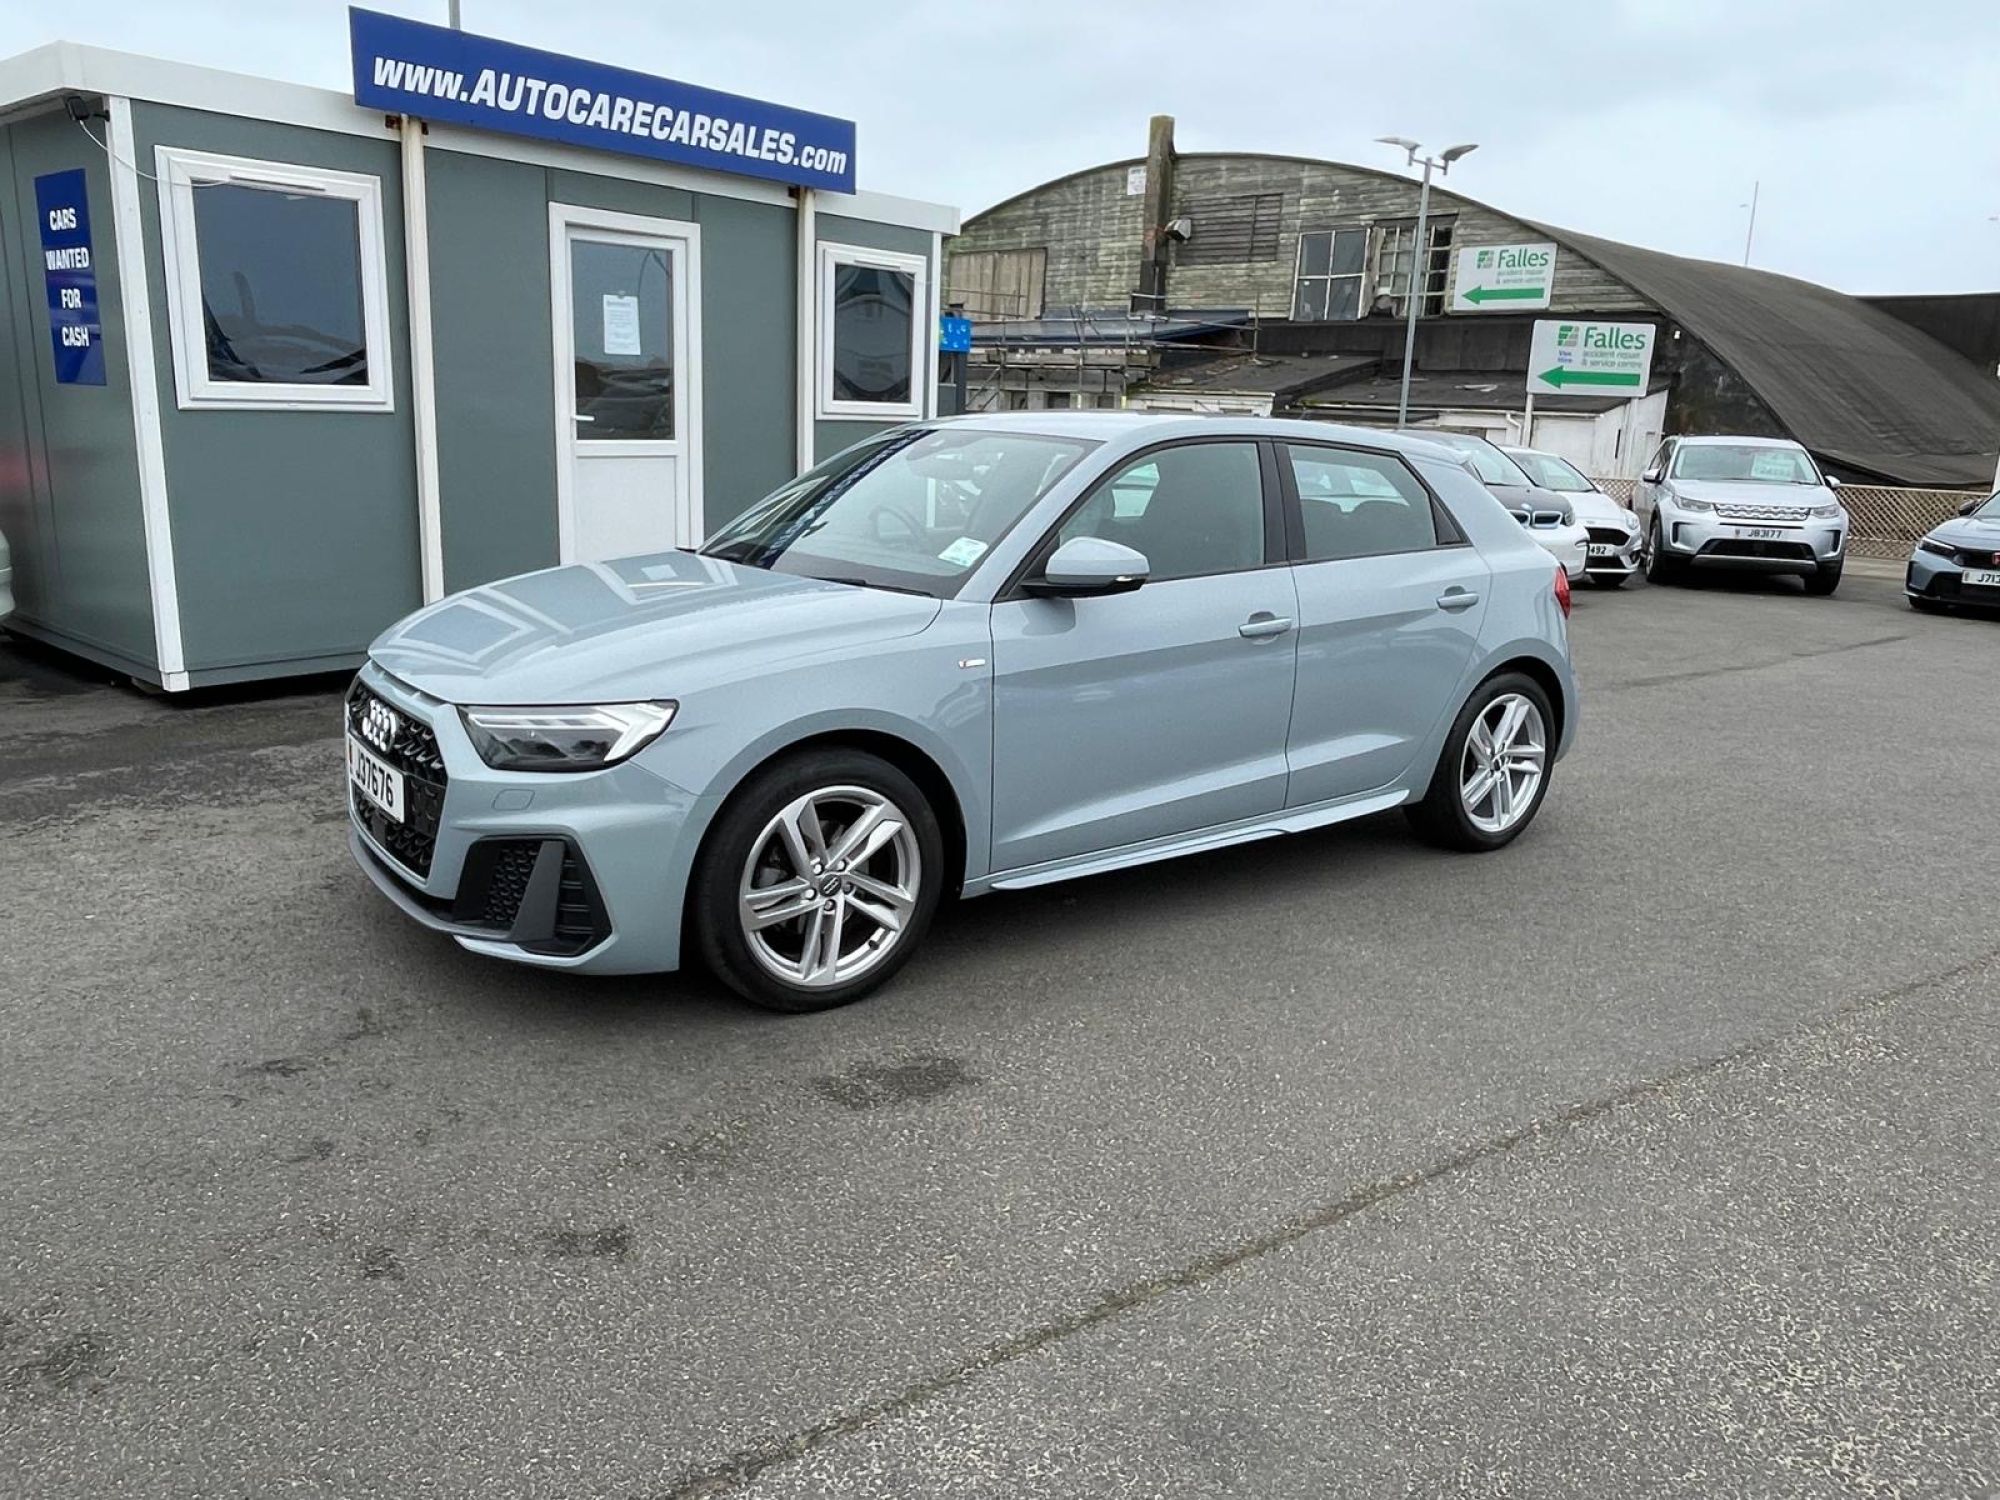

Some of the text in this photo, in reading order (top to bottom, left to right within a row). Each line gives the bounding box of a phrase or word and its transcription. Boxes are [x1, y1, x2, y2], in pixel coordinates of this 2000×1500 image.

[374, 55, 847, 175] www.AUTOCARECARSALES.com
[49, 207, 77, 231] CARS
[45, 247, 90, 270] WANTED
[1497, 248, 1550, 269] Falles
[60, 288, 82, 309] FOR
[61, 326, 90, 347] CASH
[1584, 326, 1646, 350] Falles
[1590, 545, 1607, 555] 492
[355, 750, 394, 808] J37676
